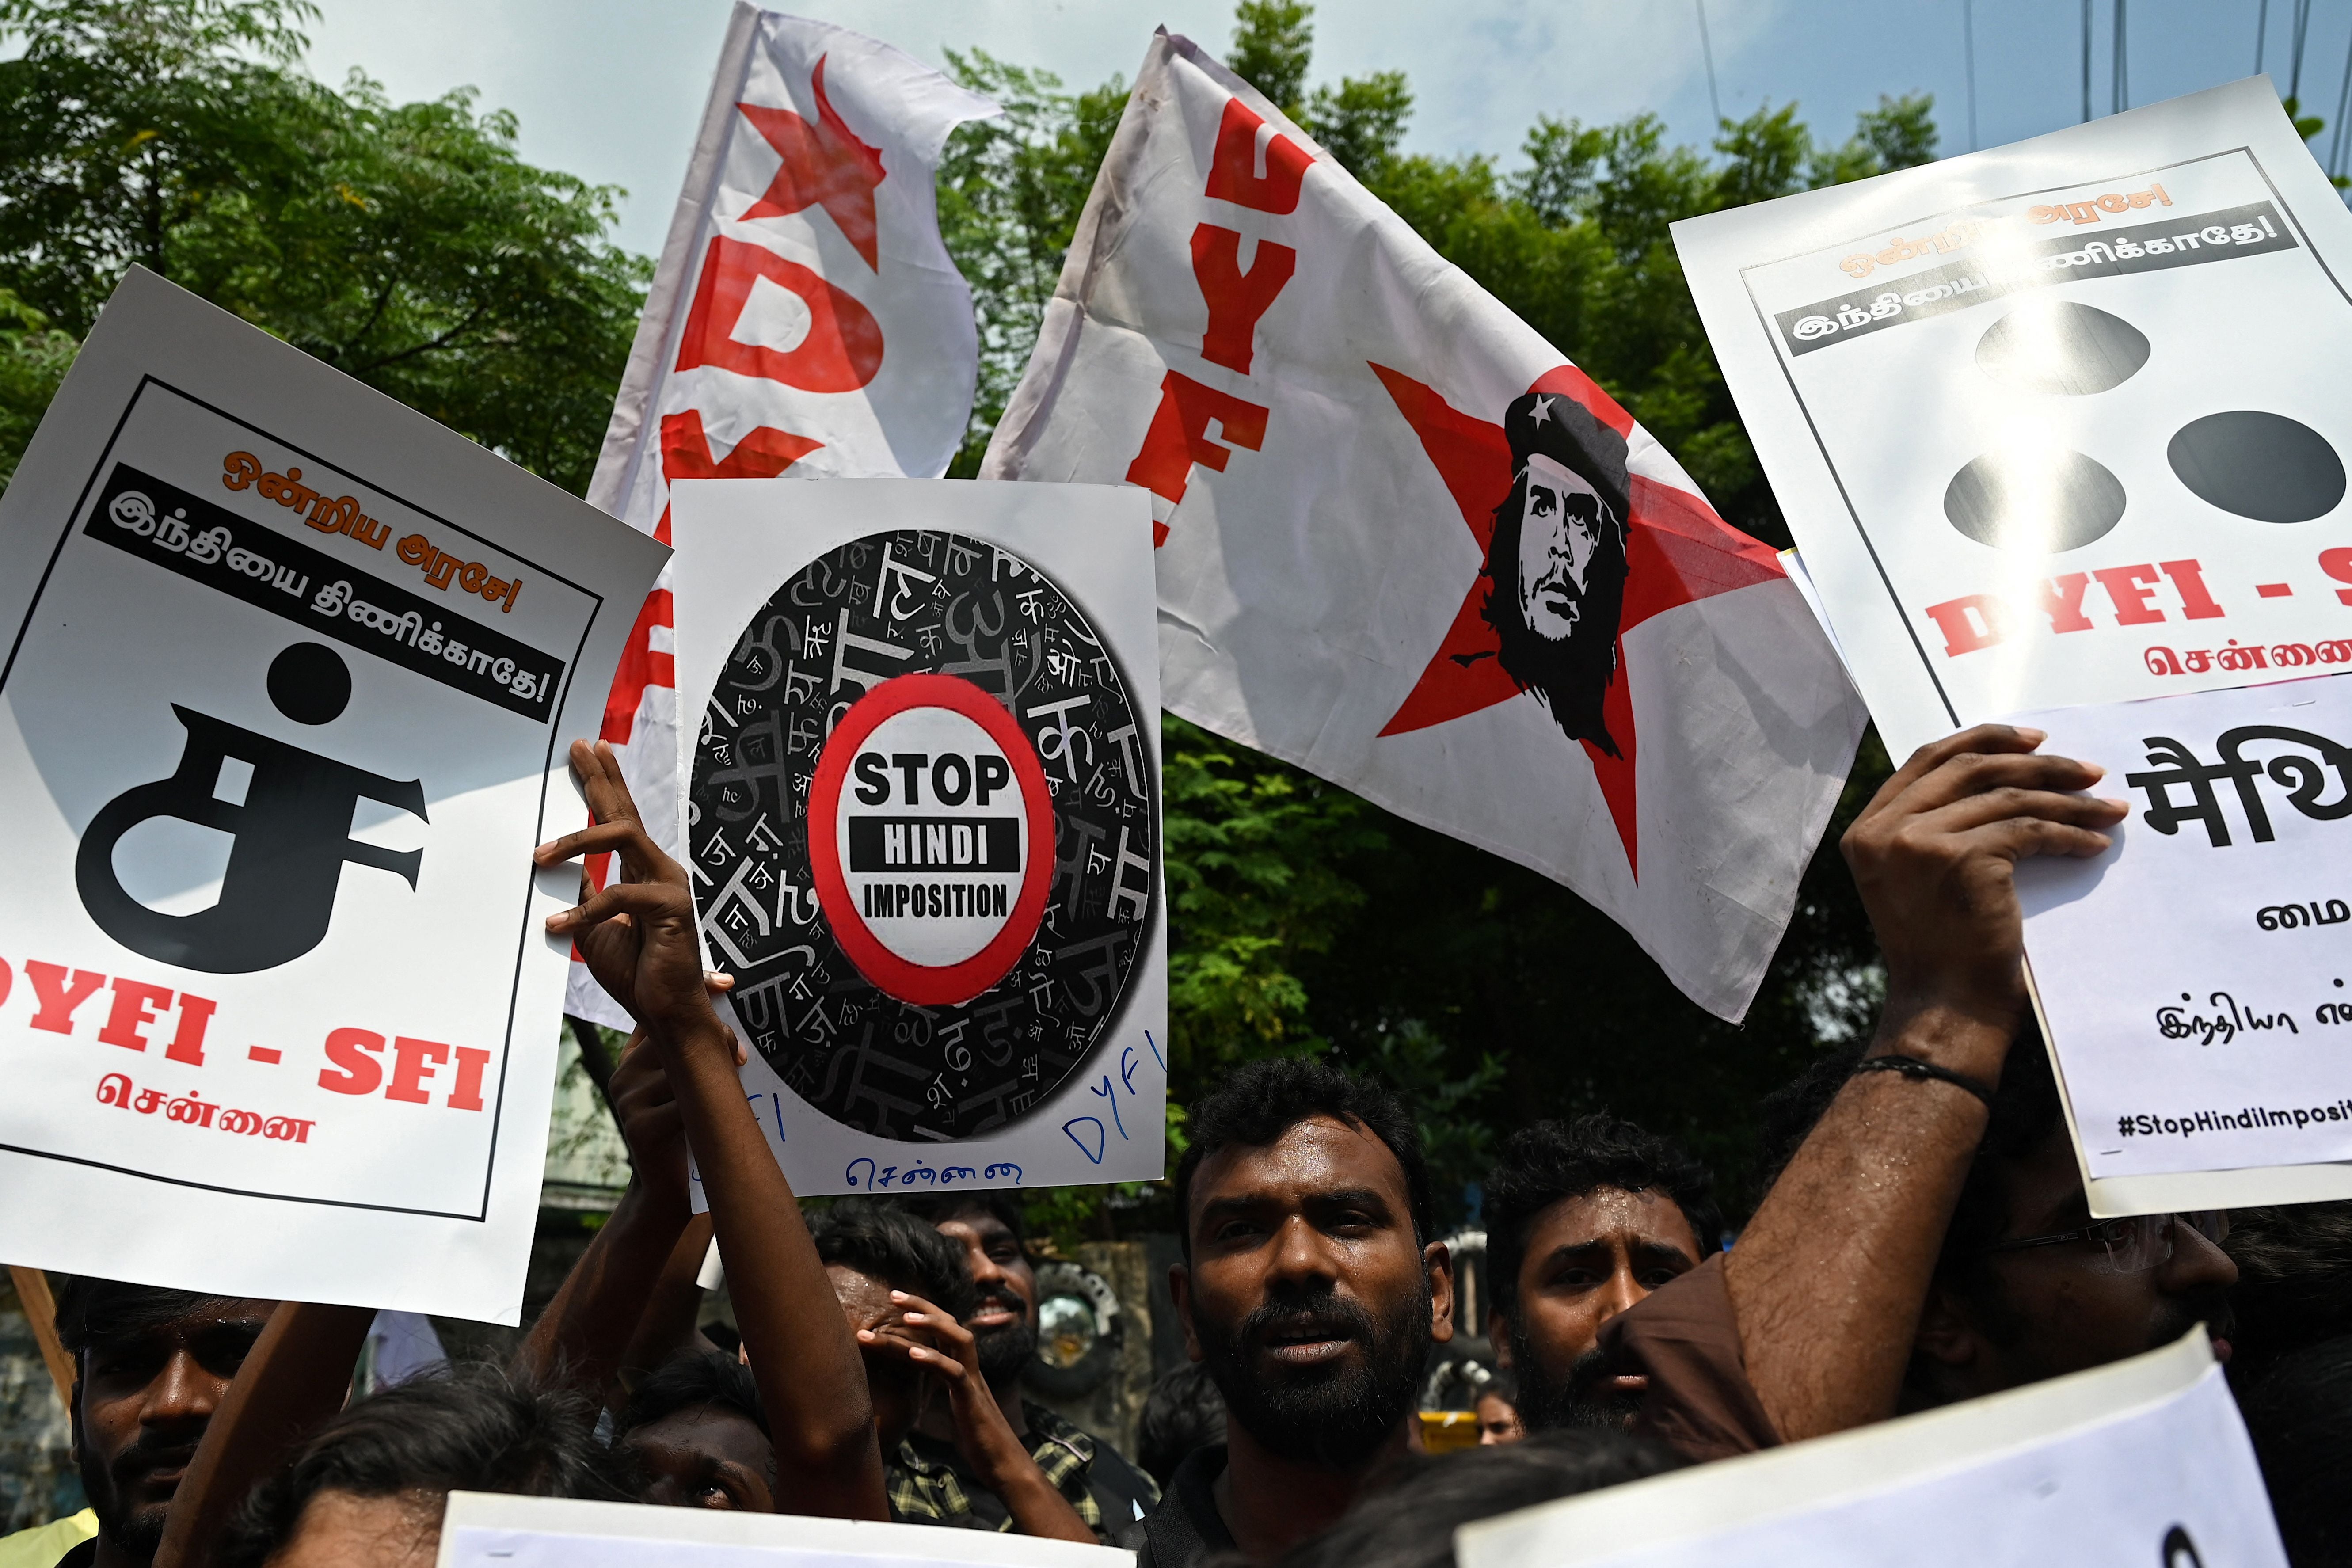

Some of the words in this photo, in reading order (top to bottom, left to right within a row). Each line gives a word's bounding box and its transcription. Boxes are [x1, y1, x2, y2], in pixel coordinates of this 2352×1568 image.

[1838, 218, 2004, 279] ஒன்றி
[2026, 183, 2174, 225] அரசே!
[2012, 214, 2278, 285] ணிக்காதே!
[222, 450, 392, 551] ஒன்றிய
[396, 533, 522, 613] அரசே!
[108, 490, 309, 598] இந்தியை
[310, 580, 551, 704] திணிக்காதே!
[855, 752, 1009, 807] STOP
[883, 823, 988, 865] HINDI
[864, 884, 1007, 918] IMPOSITION
[0, 956, 217, 1067] YFI
[317, 1027, 491, 1111] SFI
[2156, 992, 2299, 1046] இந்தியா
[96, 1073, 316, 1144] சென்னை
[1062, 1029, 1167, 1164] DYFI
